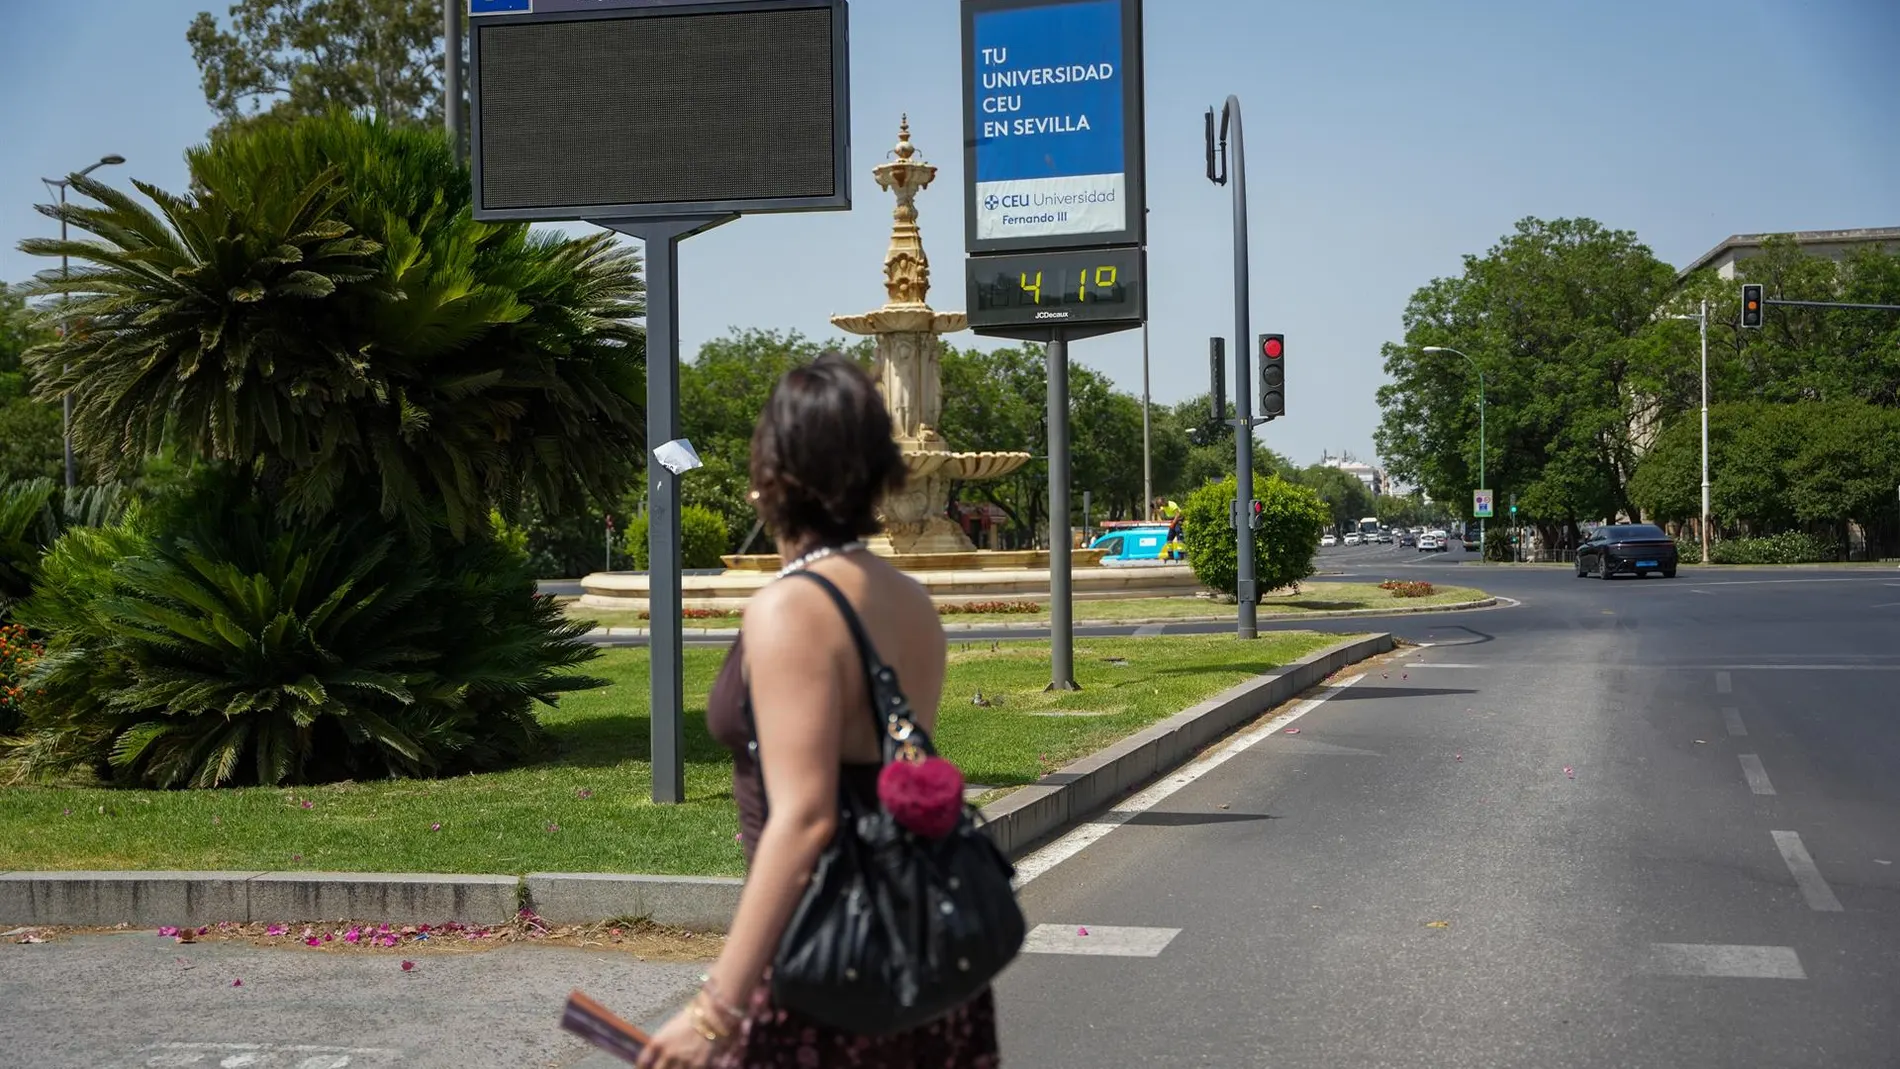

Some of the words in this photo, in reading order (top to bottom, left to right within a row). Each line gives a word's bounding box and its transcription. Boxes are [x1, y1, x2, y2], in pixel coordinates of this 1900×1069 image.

[982, 47, 1006, 65] TU
[983, 63, 1113, 89] UNIVERSIDAD
[982, 95, 1021, 113] CEU
[984, 120, 1009, 138] EN
[1013, 115, 1091, 136] SEVILLA
[1001, 194, 1029, 208] CEU
[1033, 188, 1115, 207] Universidad
[1002, 213, 1054, 225] Fernando
[1057, 212, 1067, 222] III
[1035, 311, 1069, 319] JCDecaux
